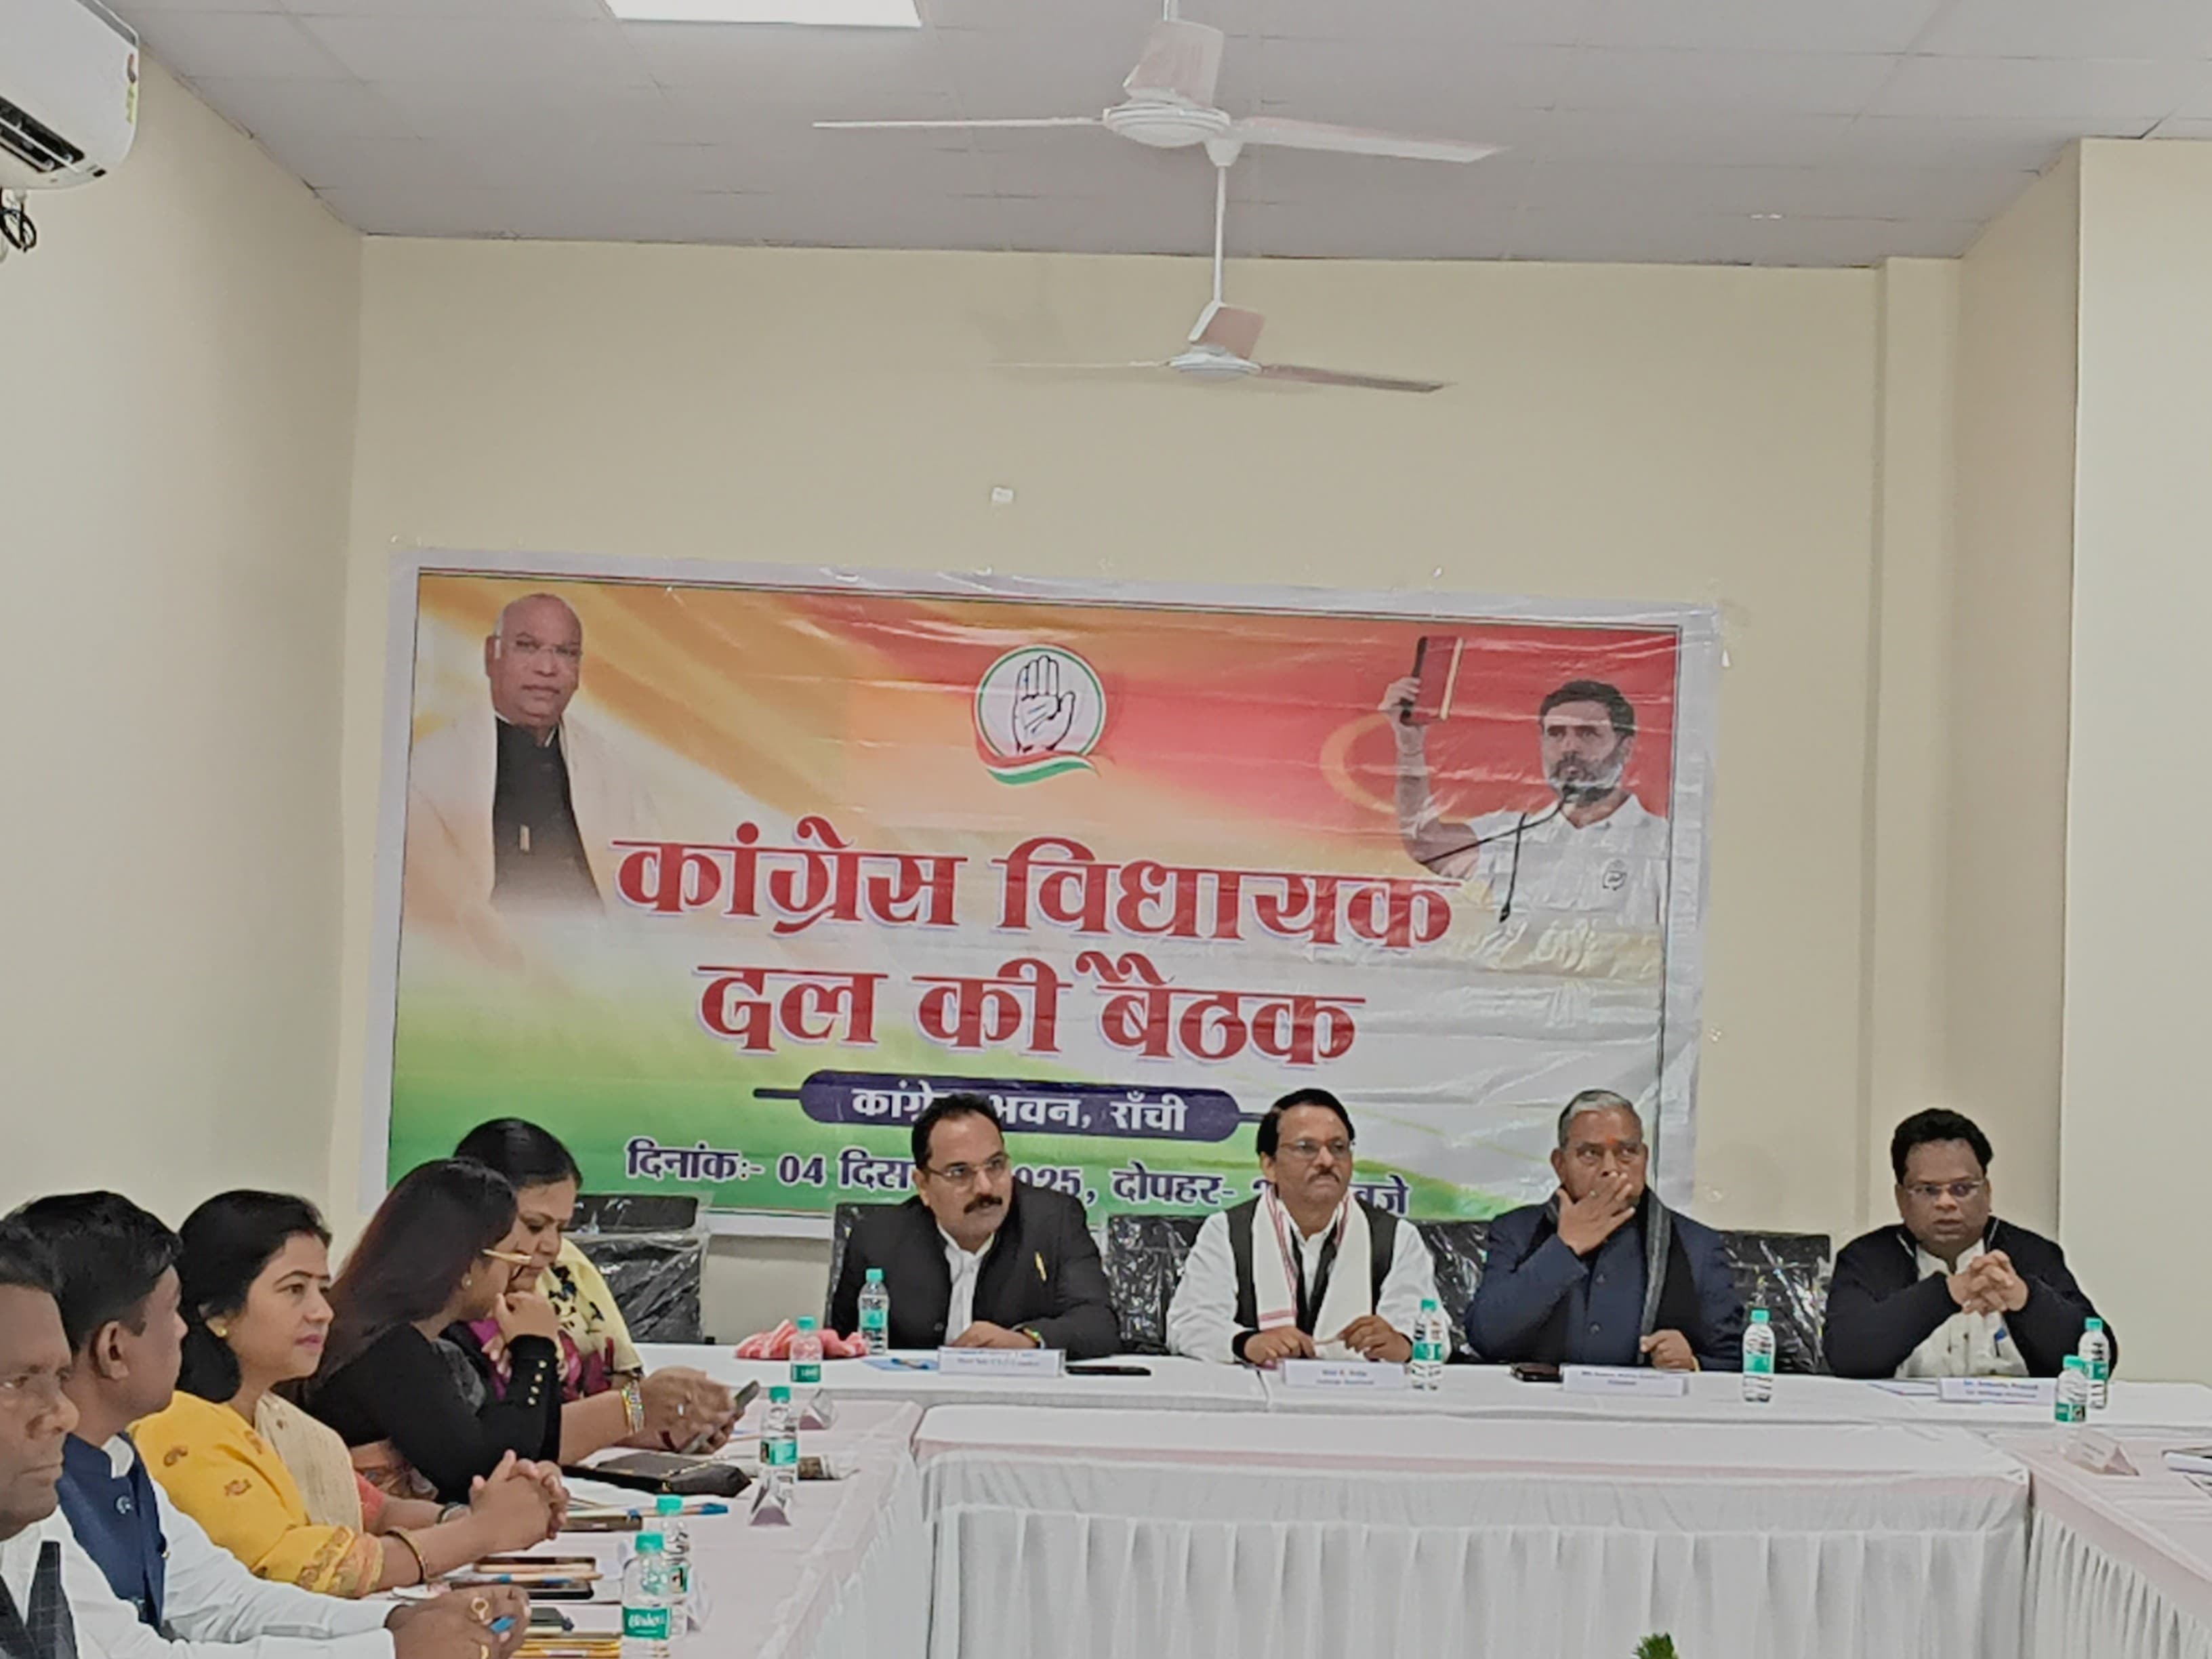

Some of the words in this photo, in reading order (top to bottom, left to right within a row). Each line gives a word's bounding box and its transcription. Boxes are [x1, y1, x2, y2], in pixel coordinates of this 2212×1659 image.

[611, 815, 968, 934] कांग्रेस
[990, 836, 1462, 947] विधायक
[697, 966, 889, 1052] दल
[912, 958, 1073, 1052] की
[1075, 950, 1366, 1065] बैठक
[851, 1079, 949, 1121] कांग्रे
[989, 1094, 1091, 1129] भवन,
[1109, 1090, 1189, 1132] राँची
[779, 1155, 823, 1185] 04
